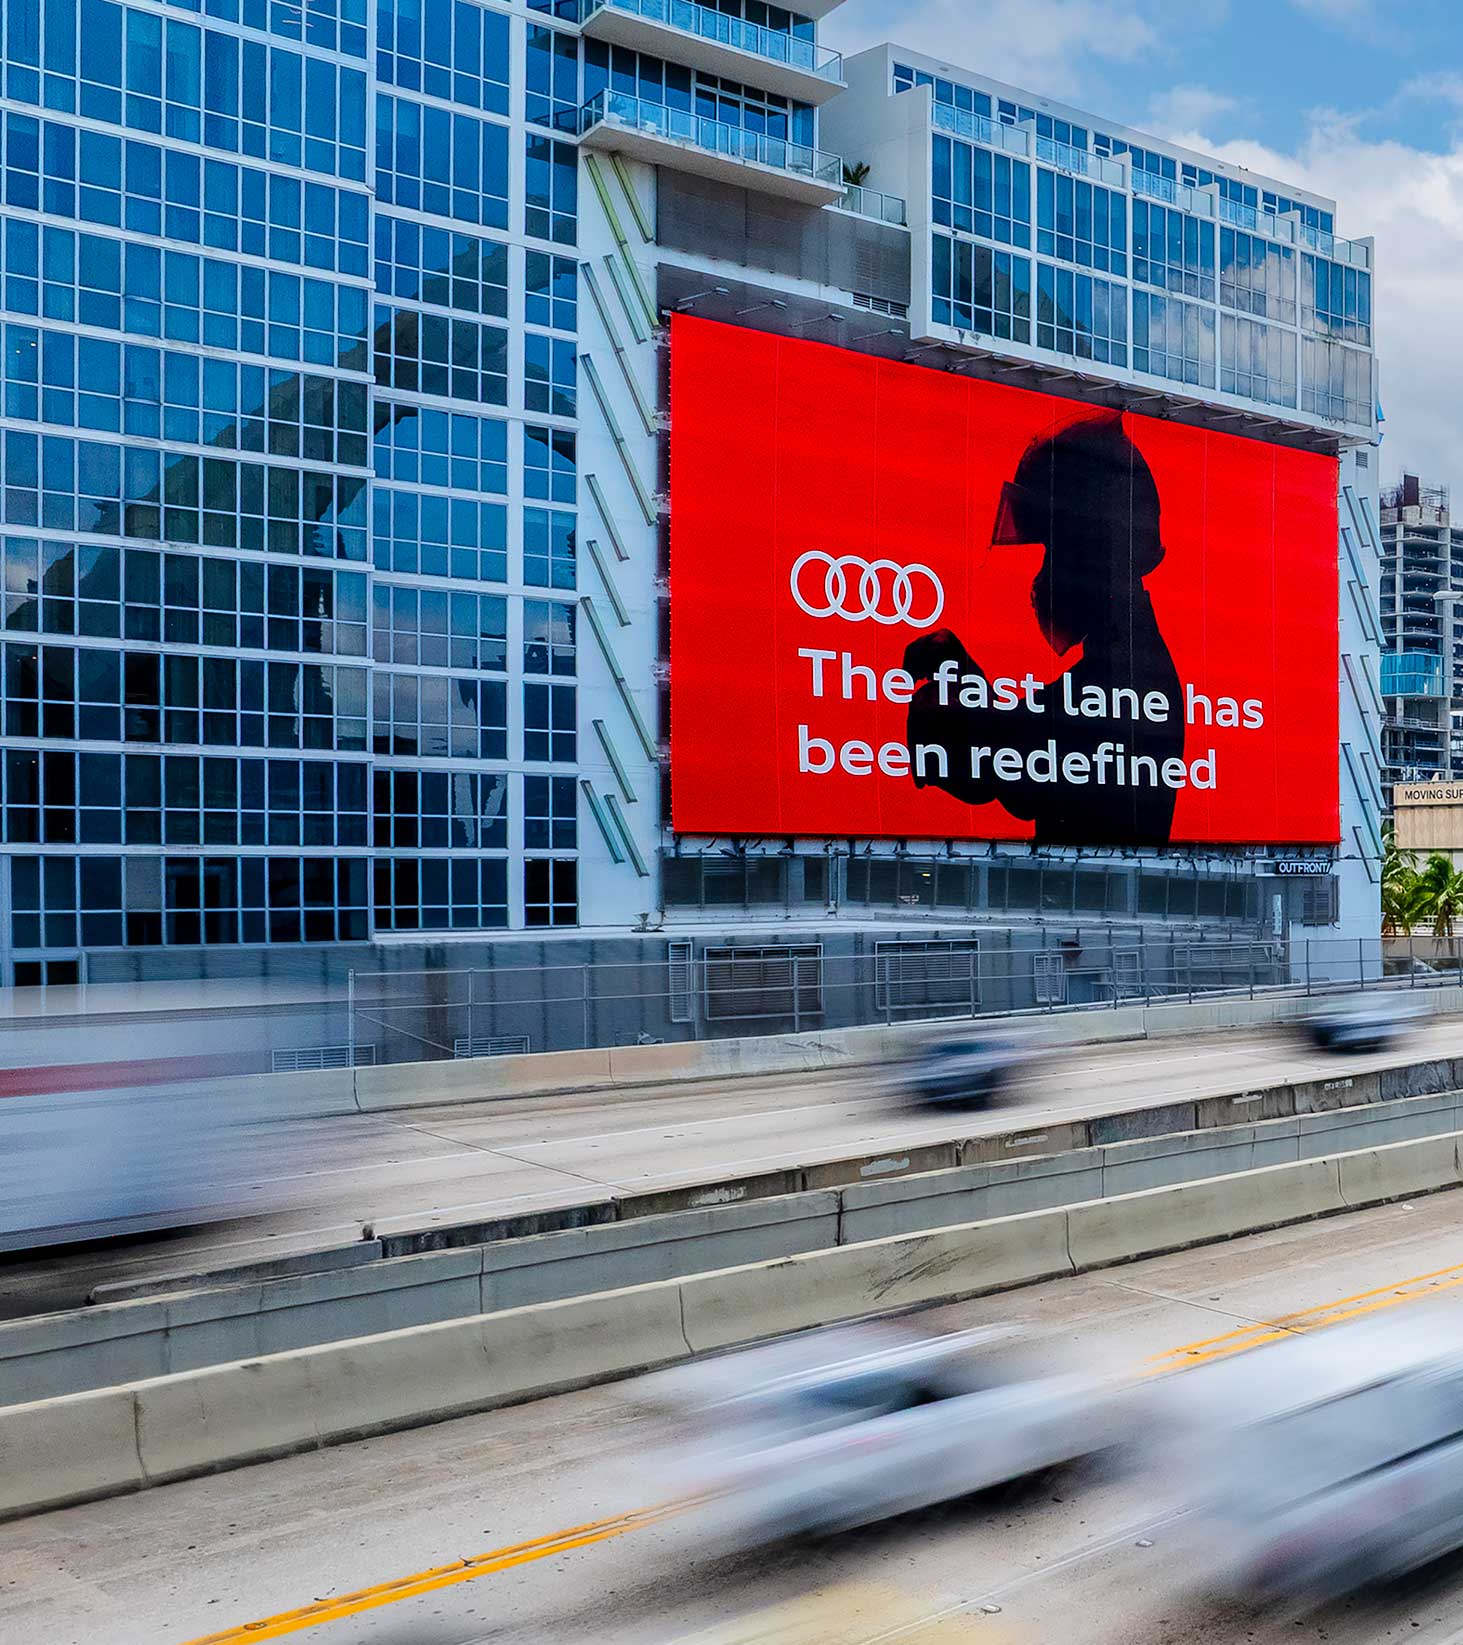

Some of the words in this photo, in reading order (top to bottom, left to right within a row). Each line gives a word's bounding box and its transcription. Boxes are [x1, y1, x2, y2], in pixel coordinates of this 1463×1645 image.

[798, 647, 916, 704] The
[933, 660, 1045, 714] fast
[1063, 671, 1170, 723] lane
[1186, 683, 1265, 729] has
[798, 724, 949, 778] been
[970, 739, 1218, 790] redefined
[1404, 790, 1443, 800] MOVING
